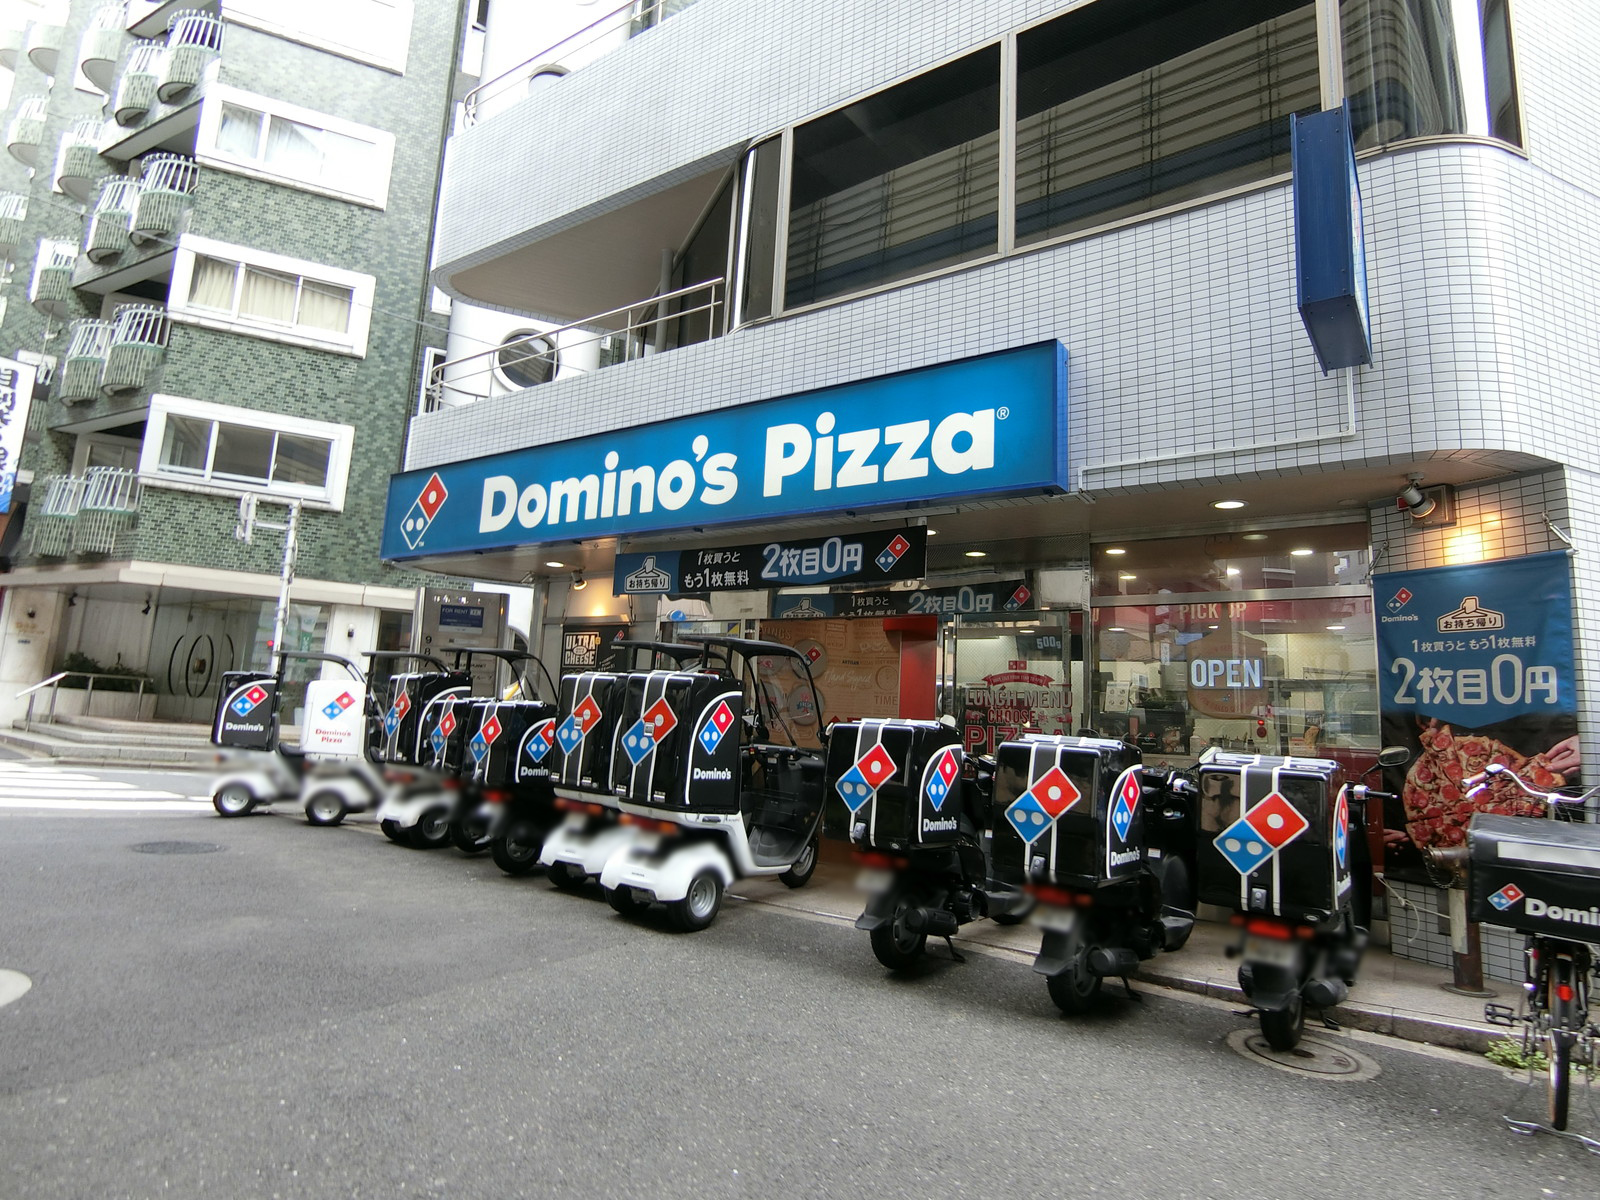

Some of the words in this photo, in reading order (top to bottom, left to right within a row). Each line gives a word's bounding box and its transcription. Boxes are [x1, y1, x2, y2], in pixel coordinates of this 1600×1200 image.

[479, 435, 738, 534] Domino's
[763, 408, 996, 498] Pizza
[697, 550, 741, 565] 1枚買うと
[761, 537, 864, 580] 2枚目0円
[628, 577, 667, 590] お持ち帰り
[683, 567, 750, 589] もう1枚無料
[850, 594, 890, 608] 1枚買うと
[907, 586, 994, 614] 2枚目0円
[1179, 602, 1219, 620] PICK
[1381, 614, 1419, 624] Domino's
[1443, 616, 1498, 630] お持ち帰り
[425, 635, 432, 644] 9
[565, 634, 596, 650] ULTRA
[1036, 635, 1062, 650] 500g
[1411, 639, 1466, 653] 1枚買うと
[1469, 634, 1536, 651] もう1枚無料
[564, 650, 595, 665] CHEESE
[1190, 658, 1263, 689] OPEN
[1391, 653, 1558, 705] 2枚目0円
[874, 695, 899, 706] TIME
[965, 690, 1018, 709] LUNCH
[1023, 690, 1073, 709] MENU
[987, 708, 1036, 724] CHOOSE
[225, 721, 264, 733] Domino's
[315, 728, 352, 737] Domino's
[321, 736, 343, 744] Pizza
[964, 724, 1066, 755] PIZ
[520, 765, 549, 777] Domin
[693, 767, 732, 780] Domino's
[923, 816, 958, 832] Domino's
[1110, 845, 1141, 867] Domino's
